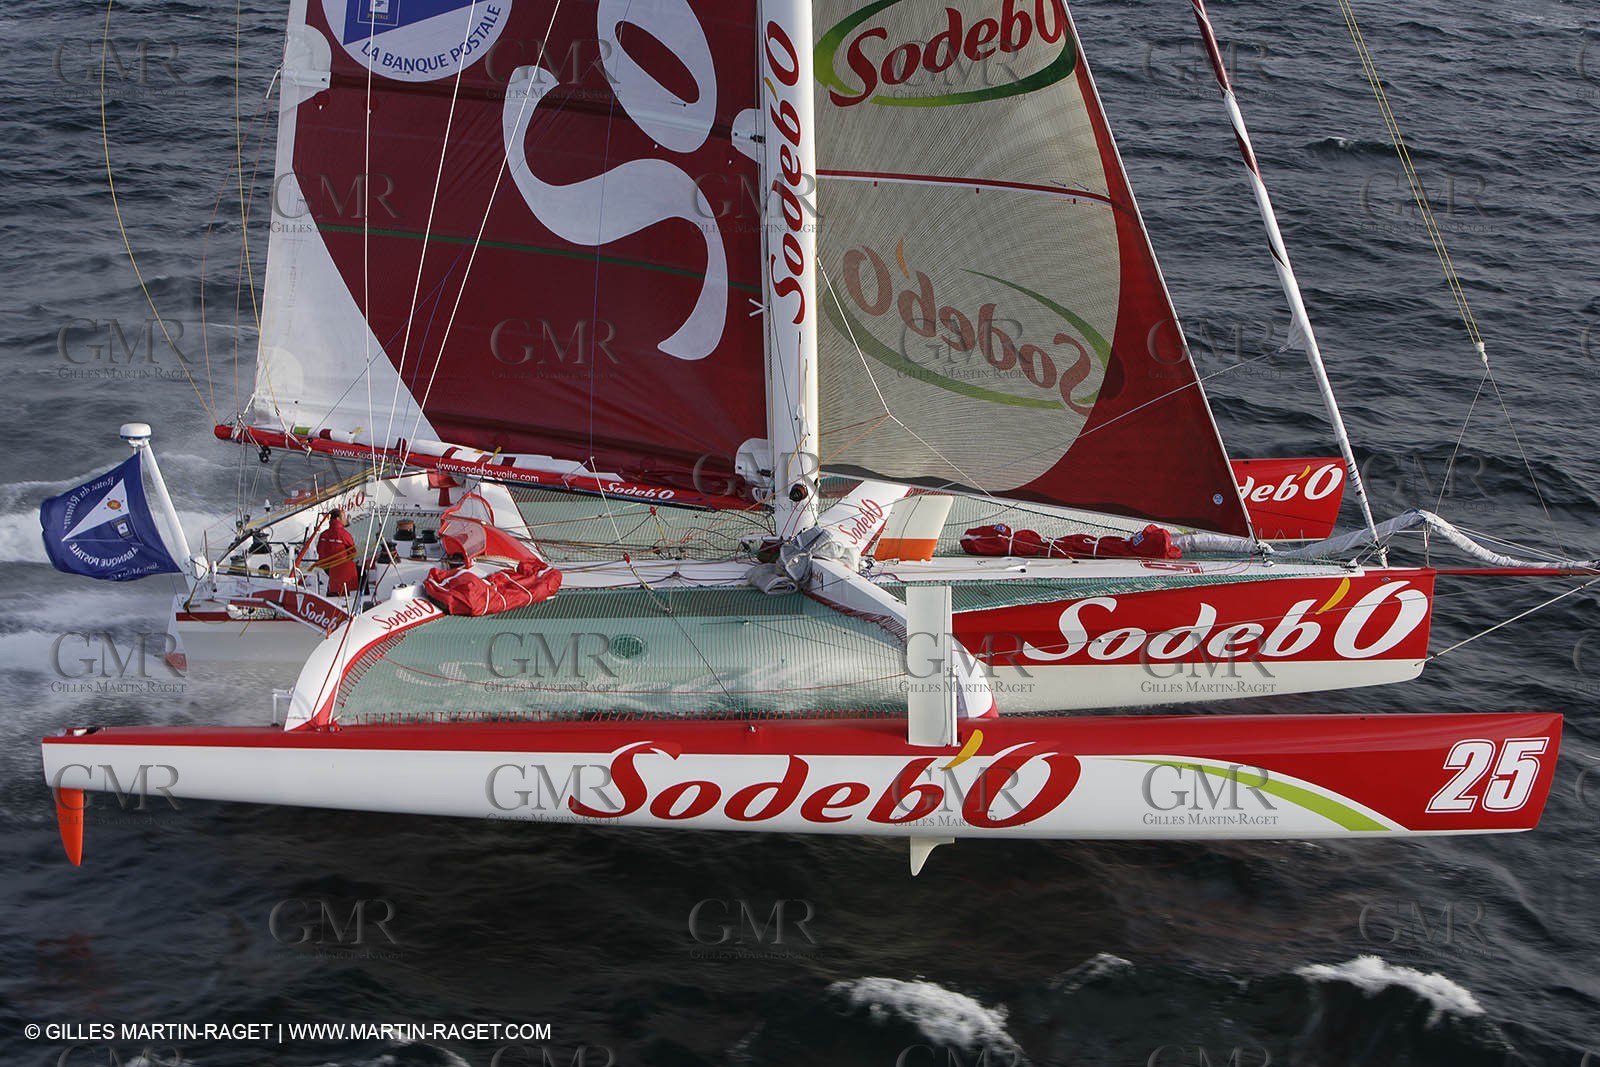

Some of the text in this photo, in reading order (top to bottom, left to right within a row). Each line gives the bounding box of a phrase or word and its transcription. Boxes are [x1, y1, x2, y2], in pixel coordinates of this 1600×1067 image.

[361, 4, 501, 74] LA BANQUE POSTALE
[435, 462, 539, 483] www.sodebo-voile.com
[1023, 577, 1429, 661] Sodeb'O
[568, 729, 1081, 829] Sodeb'O
[1424, 736, 1550, 814] 25
